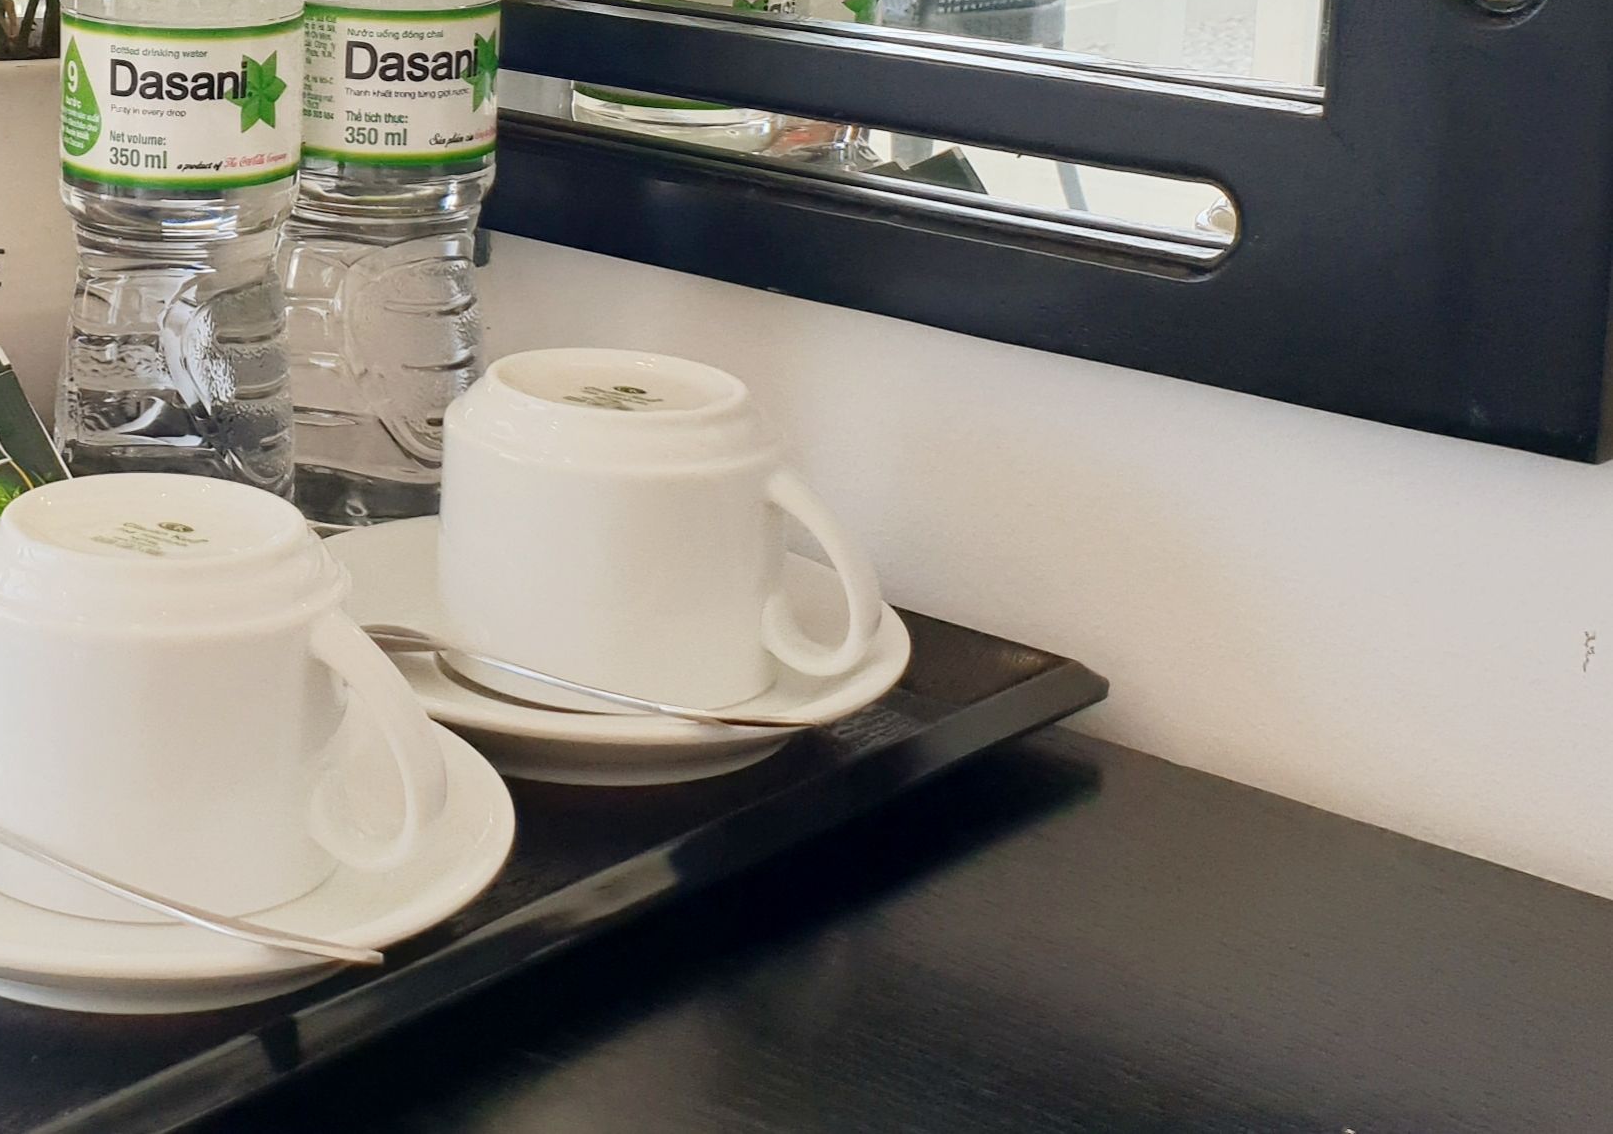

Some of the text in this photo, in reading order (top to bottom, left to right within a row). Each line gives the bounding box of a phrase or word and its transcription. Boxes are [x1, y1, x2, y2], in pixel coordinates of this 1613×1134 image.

[142, 48, 180, 59] drinking
[182, 50, 208, 58] water
[345, 39, 479, 82] Dasani
[67, 60, 79, 93] 9
[110, 58, 248, 101] Dasani
[132, 106, 140, 114] in
[142, 109, 164, 117] every
[167, 108, 186, 117] drop
[109, 130, 167, 146] Net volume:
[345, 126, 407, 146] 350 ml
[109, 146, 167, 169] 350 ml
